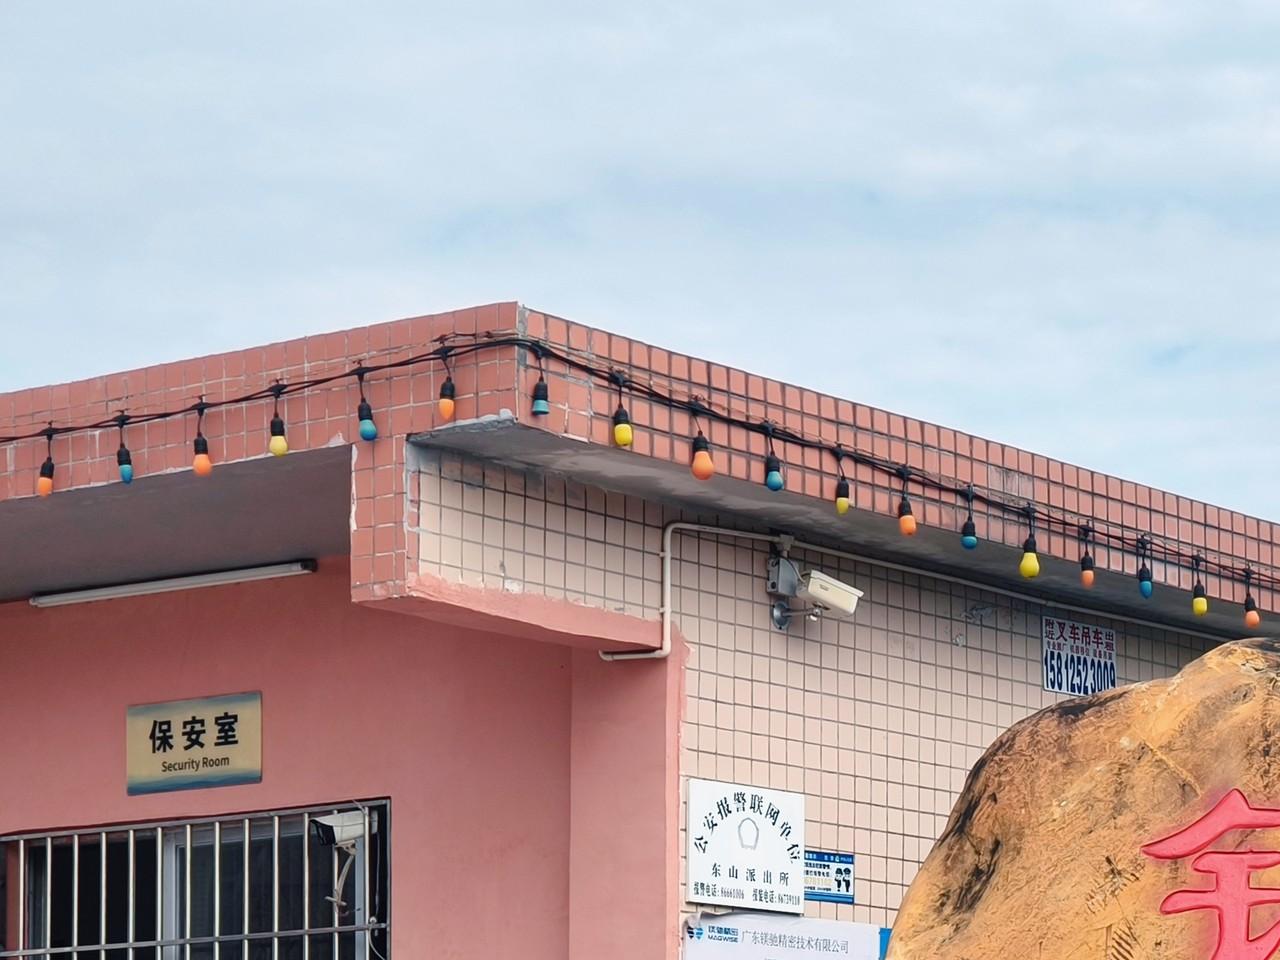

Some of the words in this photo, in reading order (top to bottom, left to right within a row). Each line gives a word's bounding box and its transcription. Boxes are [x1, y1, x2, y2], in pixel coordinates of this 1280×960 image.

[149, 712, 239, 753] 保安室
[161, 758, 201, 772] Security
[202, 757, 230, 768] Room
[694, 791, 801, 864] 公安报警联网单位
[712, 863, 789, 886] 东山派出所
[742, 930, 849, 954] 广东镁驰精密技术有限公司
